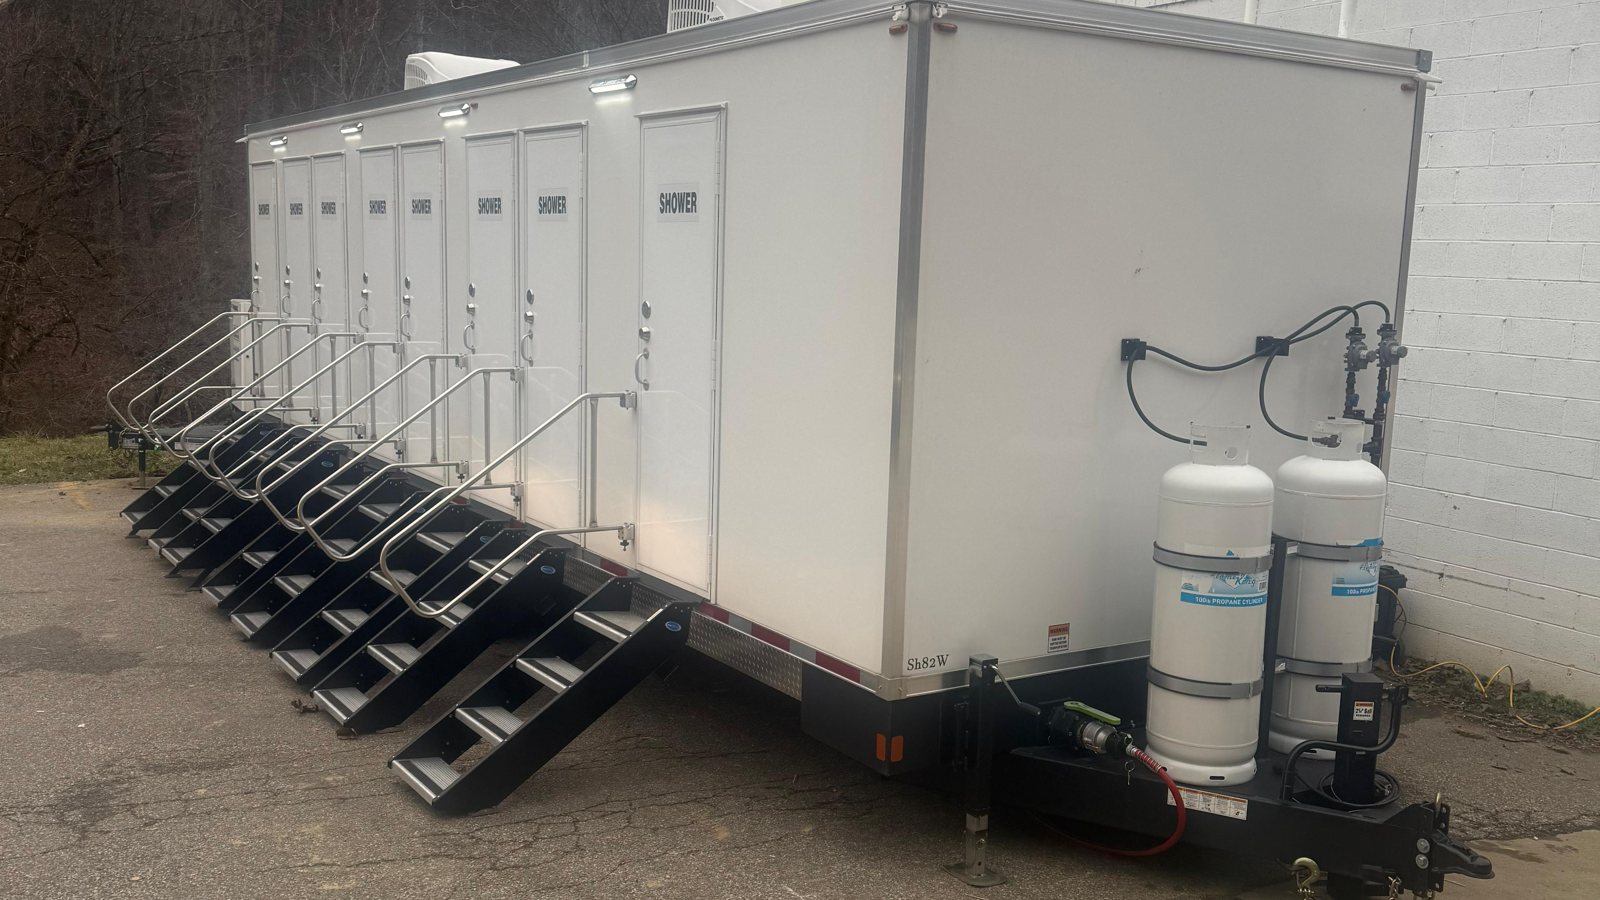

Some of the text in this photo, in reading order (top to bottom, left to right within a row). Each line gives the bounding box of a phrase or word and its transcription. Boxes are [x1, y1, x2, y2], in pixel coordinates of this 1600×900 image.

[321, 201, 336, 215] SHOWER
[369, 199, 387, 214] SHOWER
[412, 198, 432, 214] SHOWER
[478, 197, 502, 215] SHOWER
[538, 195, 567, 215] SHOWER
[658, 191, 698, 215] SHOWER
[1212, 598, 1241, 606] PROPANE
[907, 654, 949, 670] Sh82W
